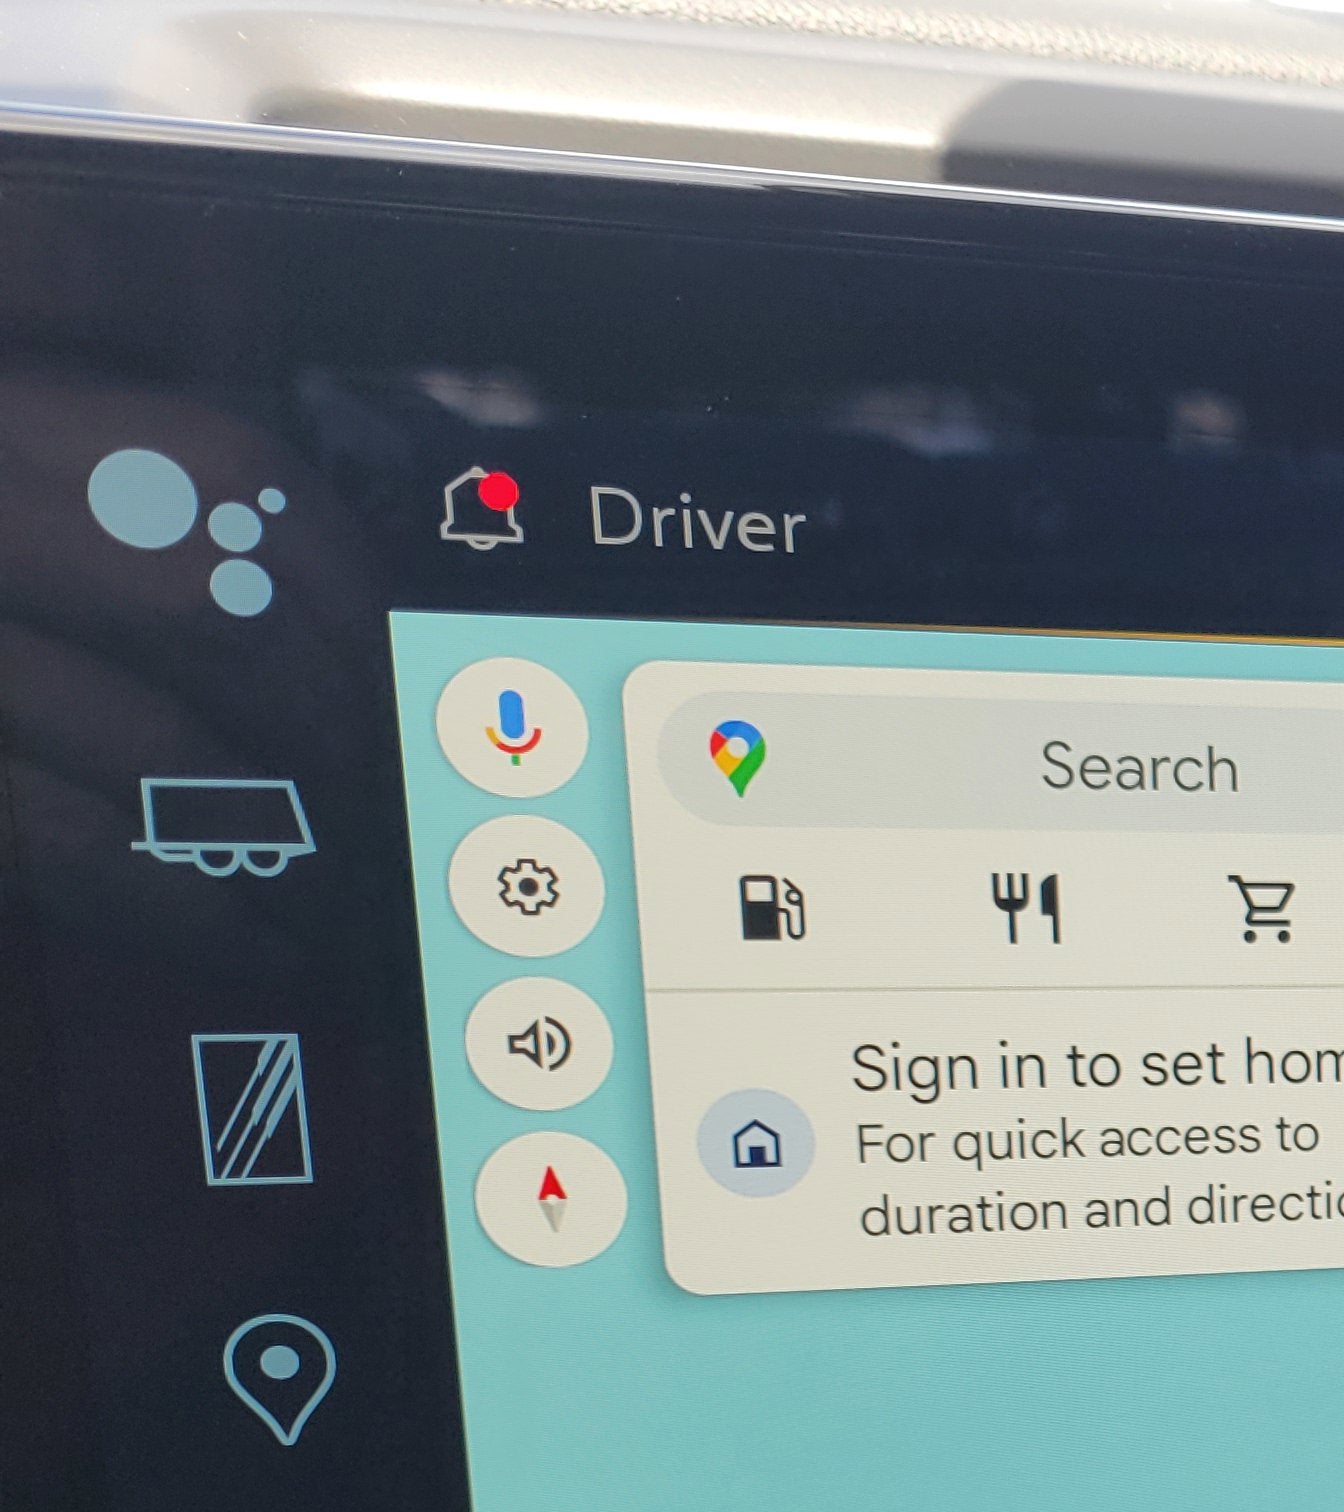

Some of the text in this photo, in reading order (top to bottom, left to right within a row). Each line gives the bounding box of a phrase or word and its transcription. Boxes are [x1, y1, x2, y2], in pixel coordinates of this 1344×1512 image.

[590, 485, 807, 554] Driver
[1041, 740, 1239, 795] Search
[852, 1041, 979, 1104] Sign
[998, 1039, 1047, 1089] in
[1066, 1045, 1122, 1088] to
[1141, 1043, 1226, 1087] set
[857, 1116, 1320, 1171] For quick access to
[860, 1191, 1068, 1237] duration
[1084, 1185, 1172, 1229] and
